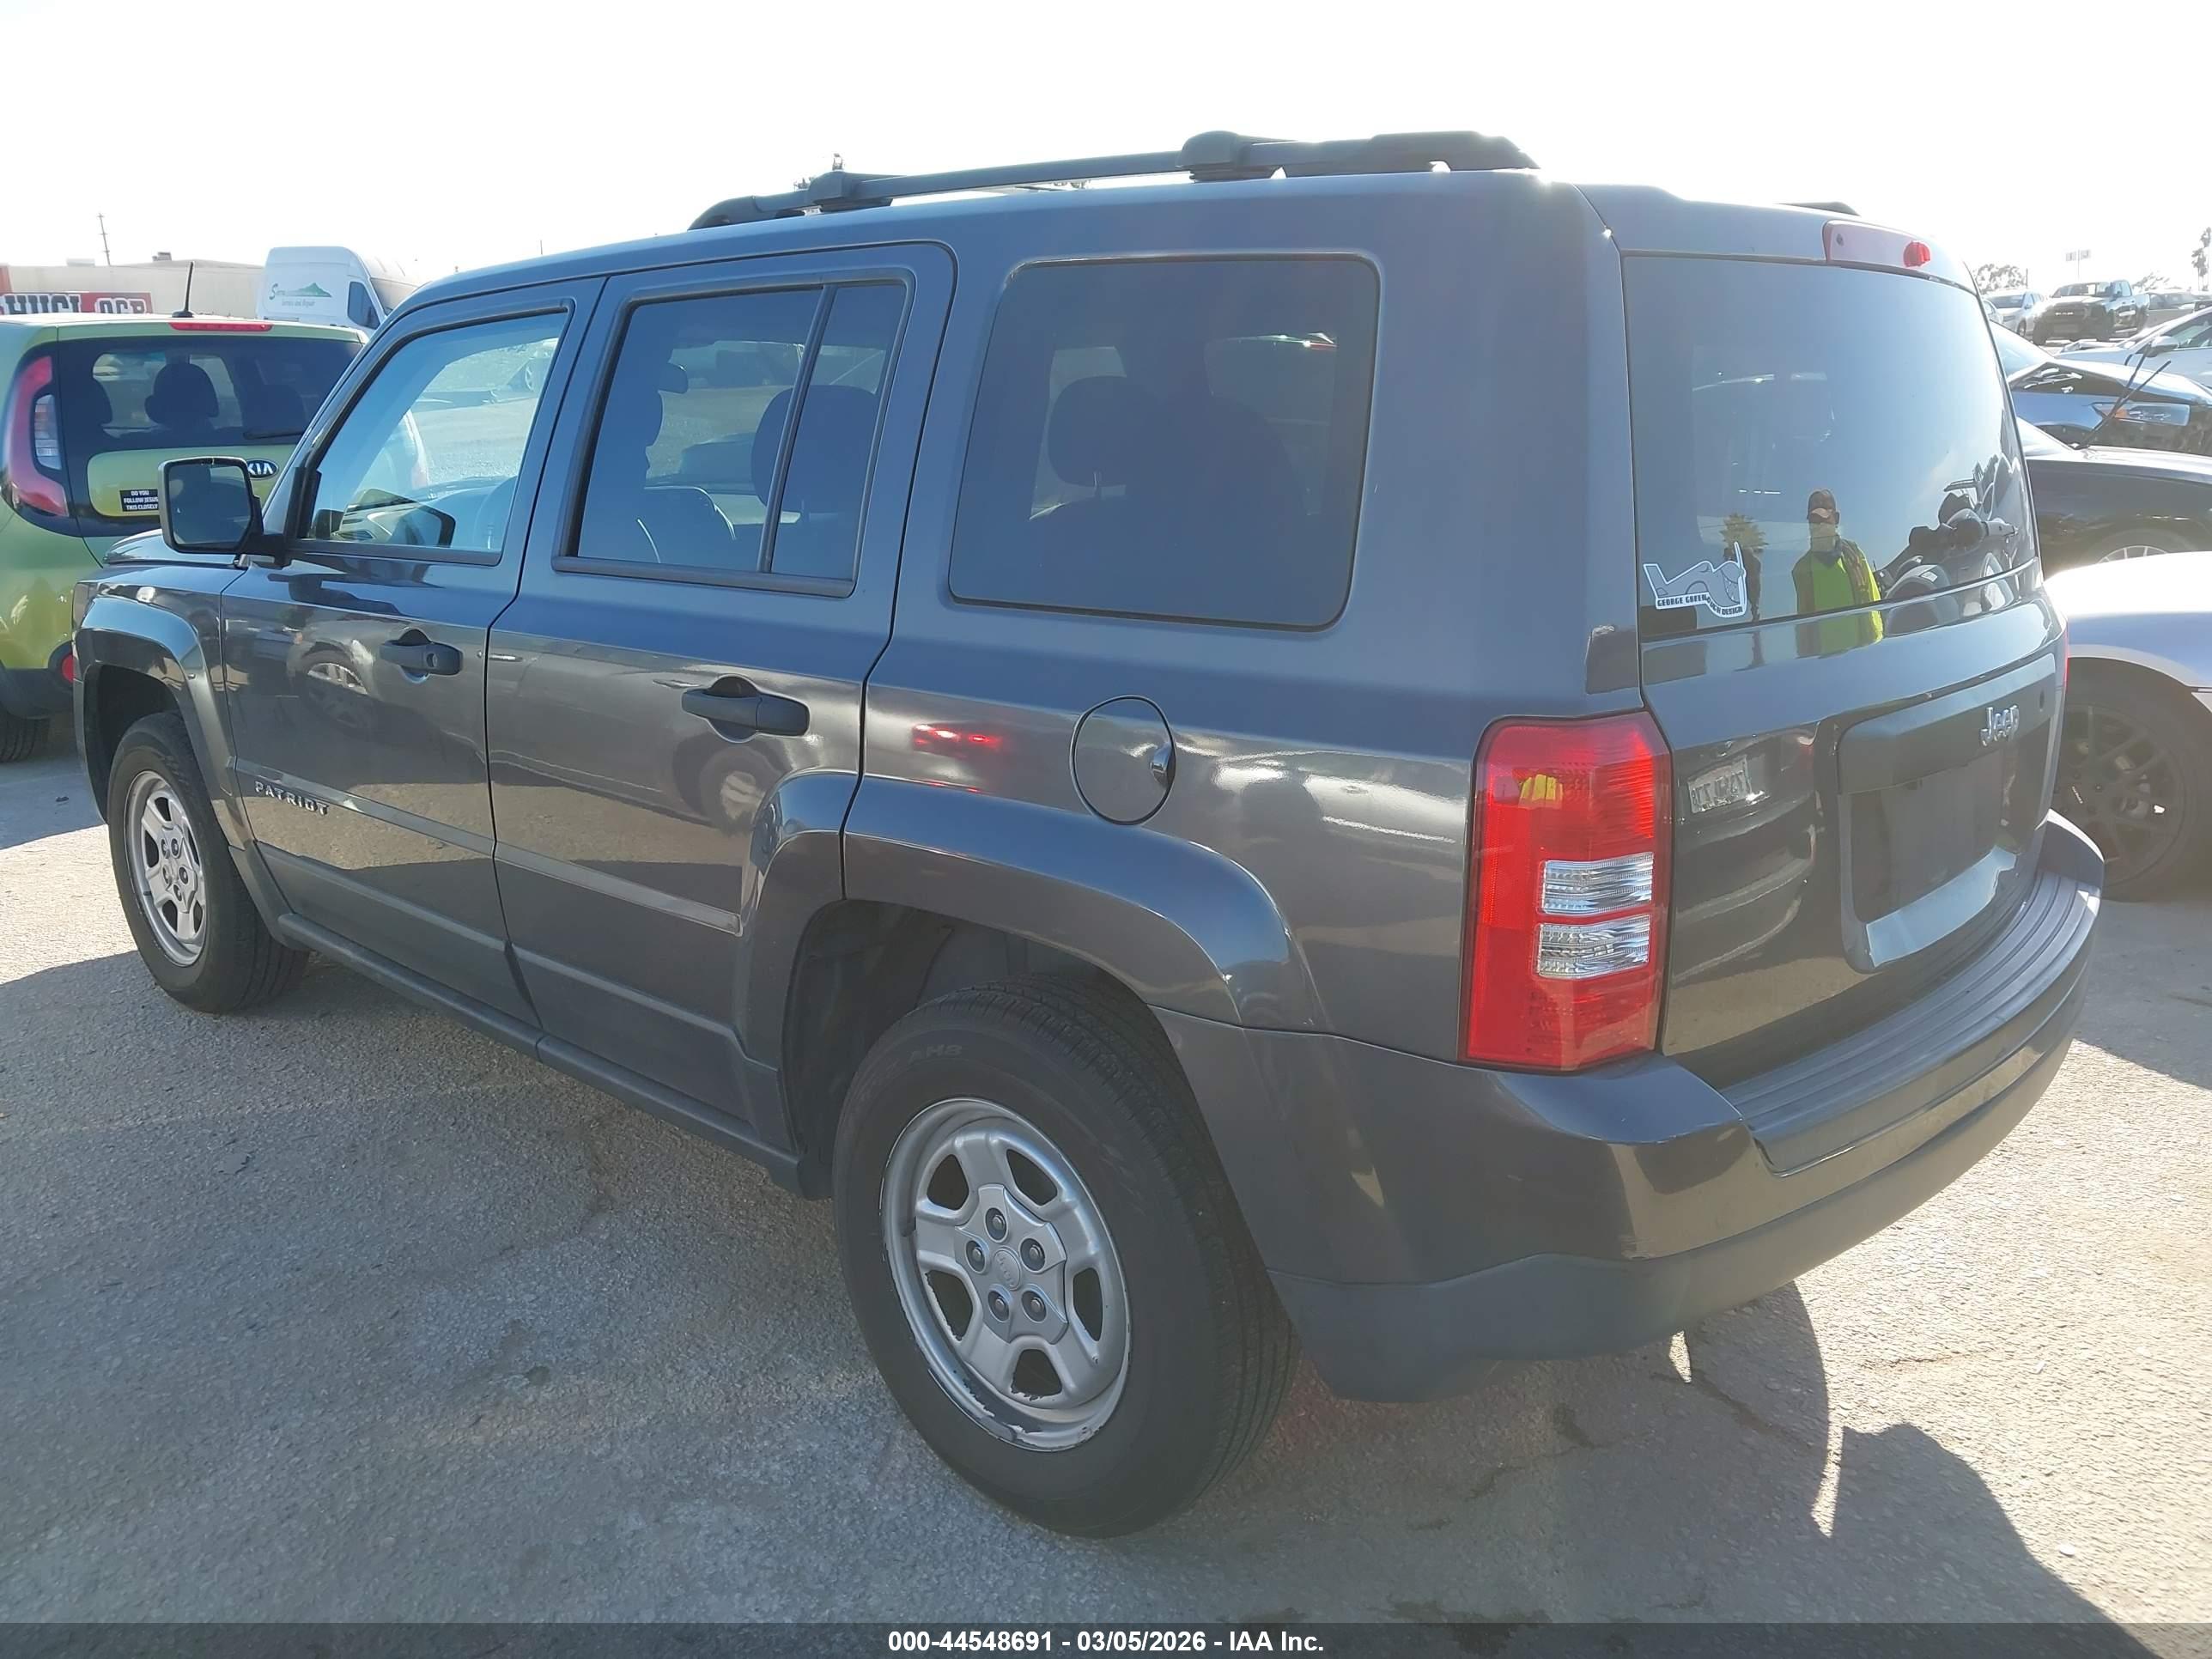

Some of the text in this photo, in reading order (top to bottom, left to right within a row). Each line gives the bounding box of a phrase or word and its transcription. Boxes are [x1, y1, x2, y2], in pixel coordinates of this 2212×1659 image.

[1657, 597, 1684, 606] GEORGE
[1721, 605, 1743, 616] DESIGN
[1978, 705, 2020, 746] Jeep
[255, 781, 330, 816] PATRIOT
